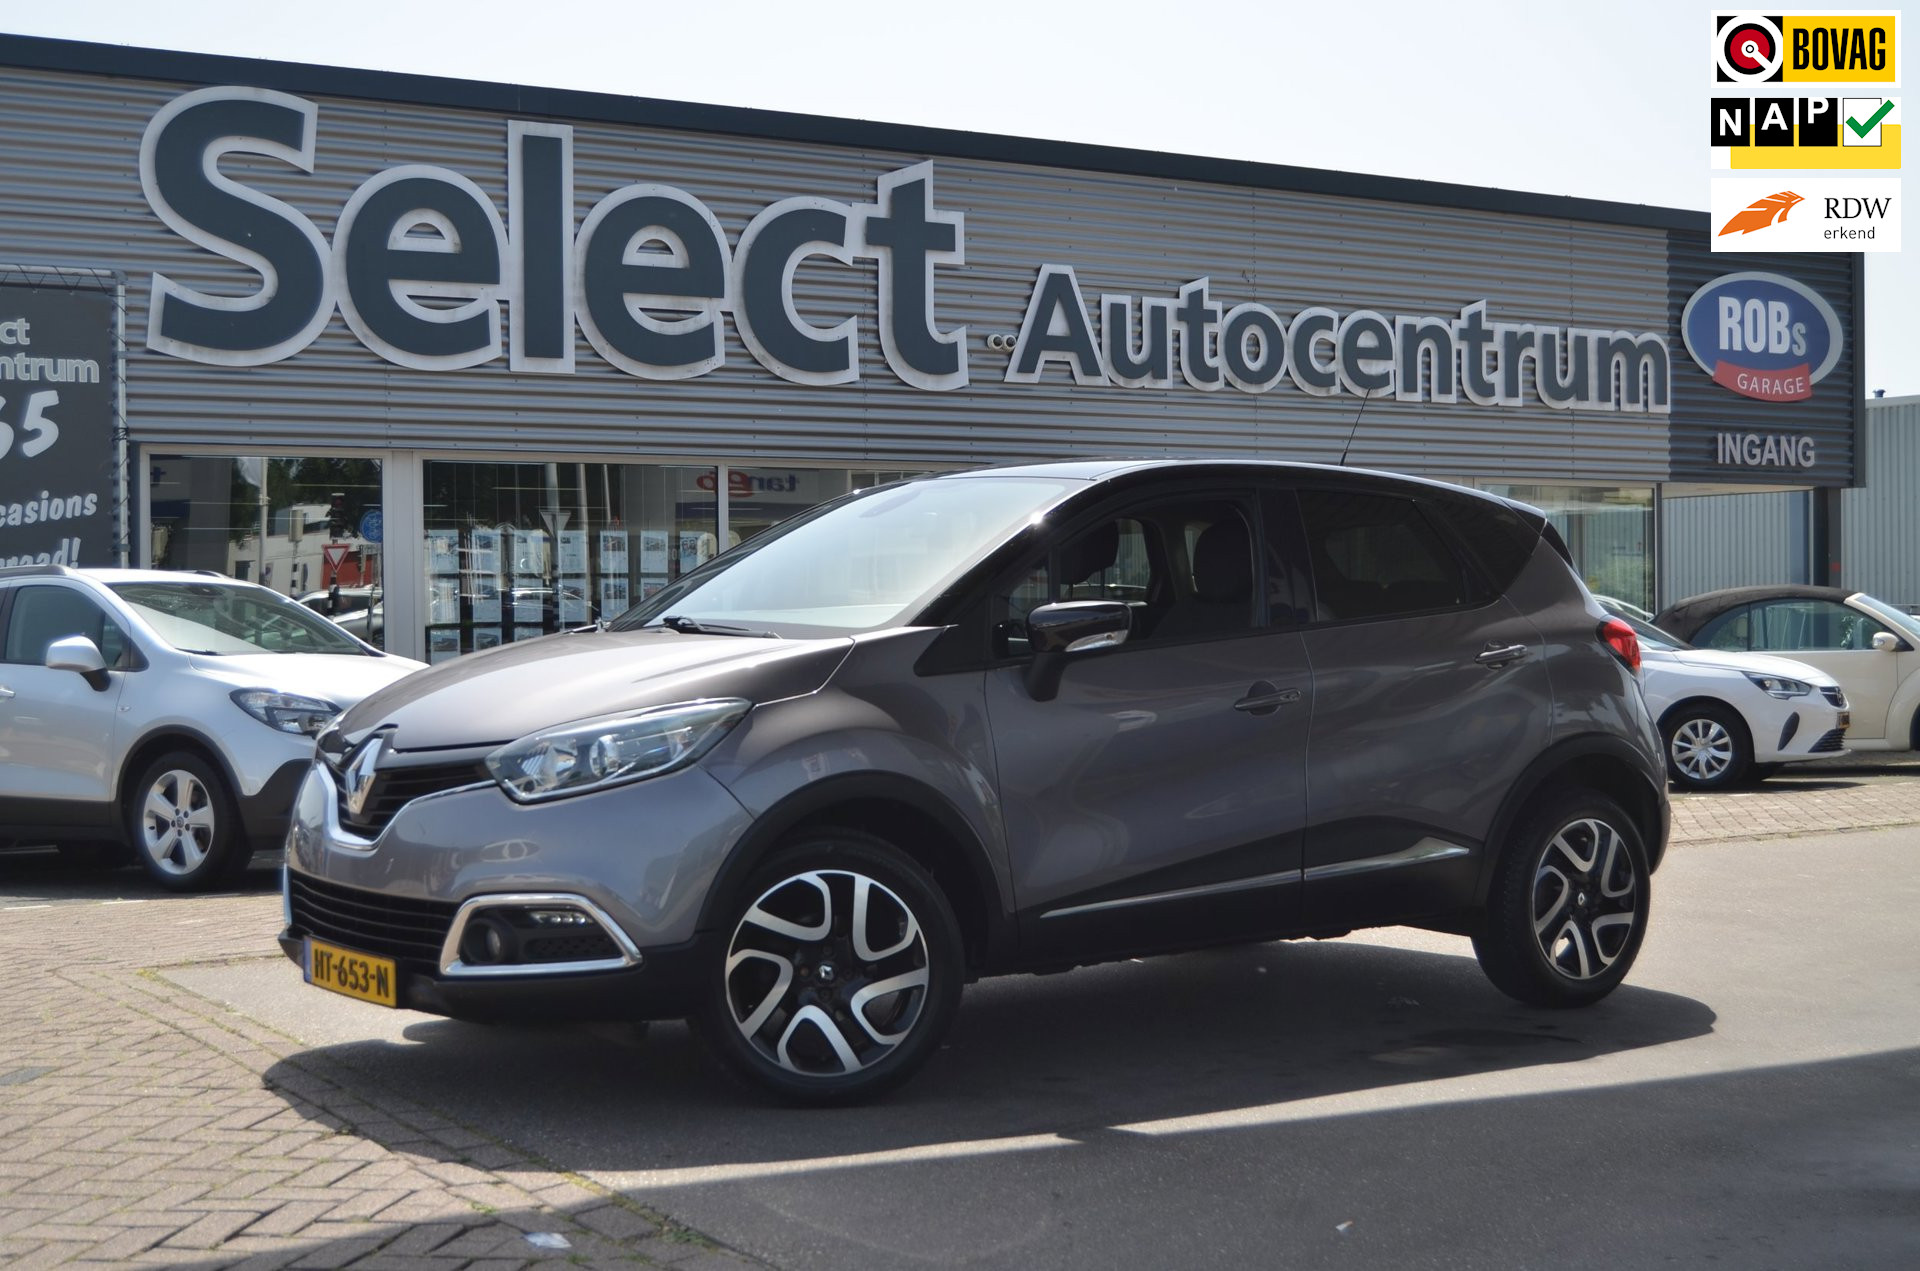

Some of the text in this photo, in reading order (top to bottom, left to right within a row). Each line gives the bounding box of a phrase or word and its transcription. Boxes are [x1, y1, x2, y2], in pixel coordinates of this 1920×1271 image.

[139, 85, 1671, 414] Select Autocentrum
[1737, 372, 1805, 395] GARAGE
[1717, 432, 1815, 468] INGANG
[314, 948, 389, 998] HT-653-N
